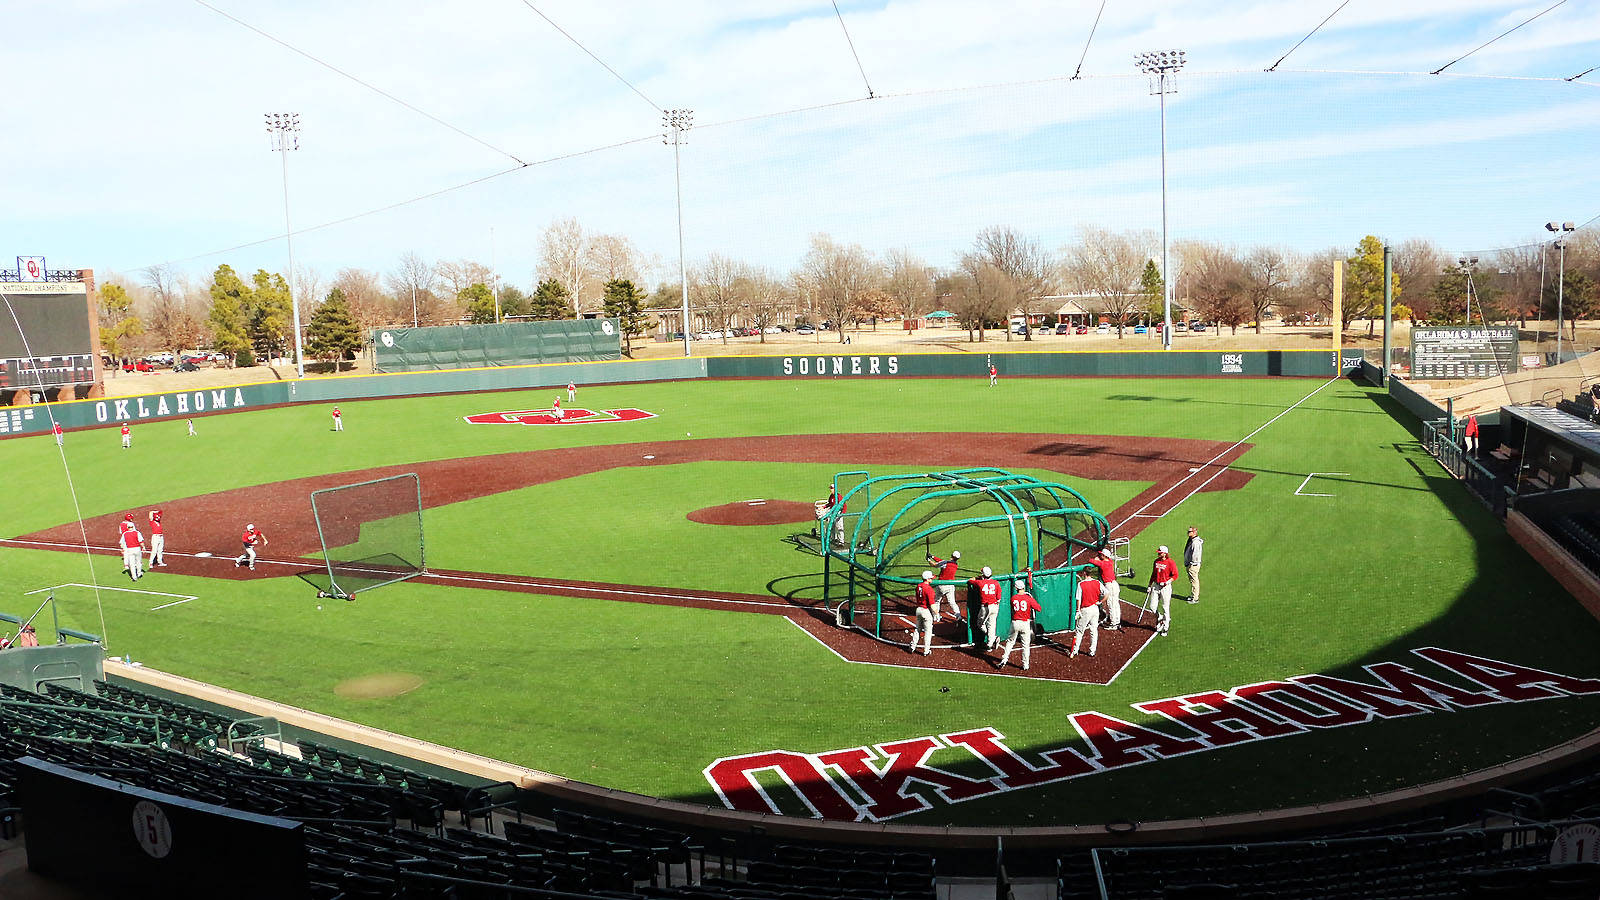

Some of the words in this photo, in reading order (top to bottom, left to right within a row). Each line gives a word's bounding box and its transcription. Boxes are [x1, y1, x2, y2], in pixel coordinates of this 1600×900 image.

[27, 260, 40, 278] OU
[1415, 330, 1460, 340] OKLAHOMA
[1471, 329, 1513, 338] BASEBALL
[783, 356, 899, 376] SOONERS
[1221, 354, 1243, 365] 1994
[95, 387, 245, 422] OKLAHOMA
[981, 583, 996, 595] 42
[1012, 599, 1028, 613] 39
[703, 645, 1600, 823] OKLAHOMA
[146, 815, 157, 844] 5
[1576, 838, 1585, 862] 1
